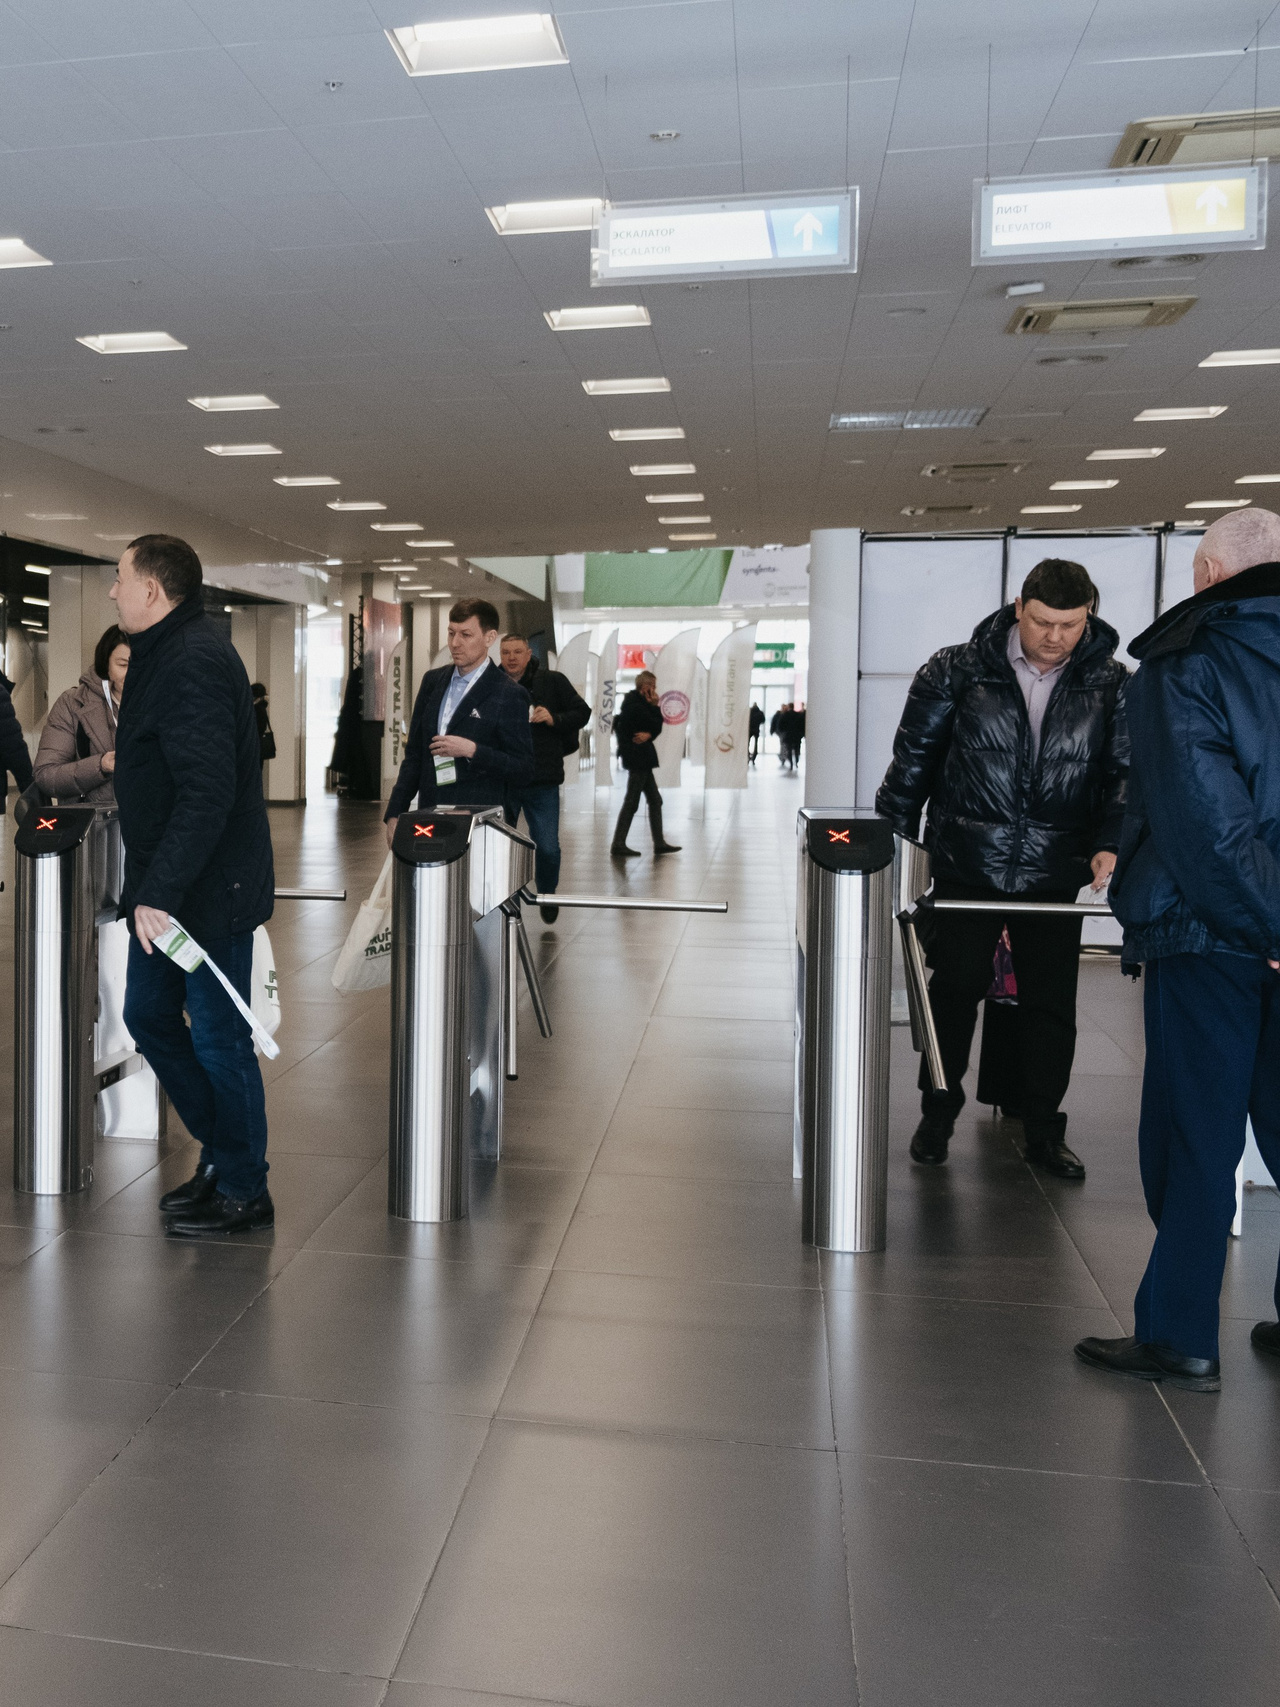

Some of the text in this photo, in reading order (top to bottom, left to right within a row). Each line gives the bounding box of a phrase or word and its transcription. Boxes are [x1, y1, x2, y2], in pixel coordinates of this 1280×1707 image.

[996, 204, 1029, 215] ЛИФТ
[612, 227, 675, 240] ЭСКАЛАТОР
[995, 221, 1052, 233] ELEVATOR
[611, 244, 671, 257] ESCALATOR
[393, 656, 401, 714] TRADE
[364, 942, 392, 957] TRAD
